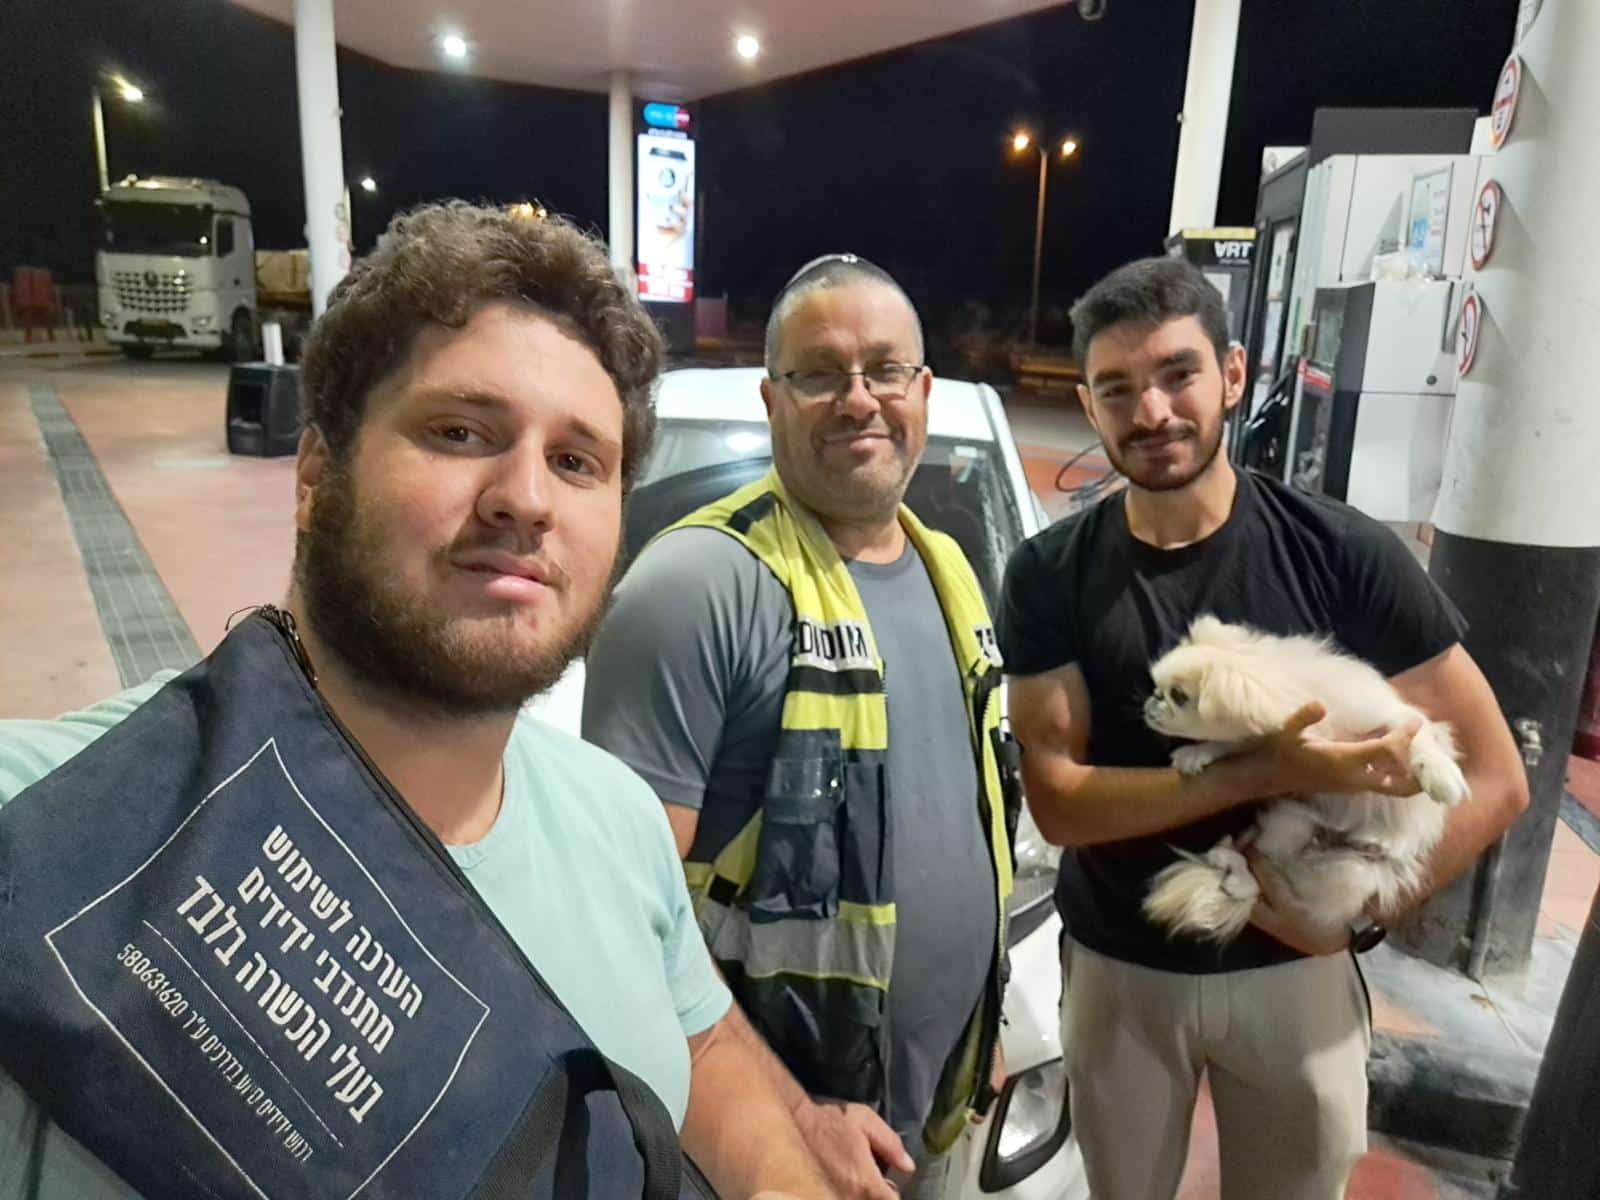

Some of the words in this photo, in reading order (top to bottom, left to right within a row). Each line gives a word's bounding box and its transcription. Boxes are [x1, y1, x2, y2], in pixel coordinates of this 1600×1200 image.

[795, 621, 870, 660] DIDIM
[176, 874, 247, 967] בלבד
[236, 866, 316, 954] ידידים
[261, 824, 354, 934] לשימוש
[117, 944, 189, 1017] 580631620
[234, 951, 332, 1062] הכשרה
[312, 949, 395, 1055] מתנדבי
[345, 925, 423, 1019] הערכה
[232, 1074, 264, 1104] סוע
[325, 1043, 384, 1125] בעלי
